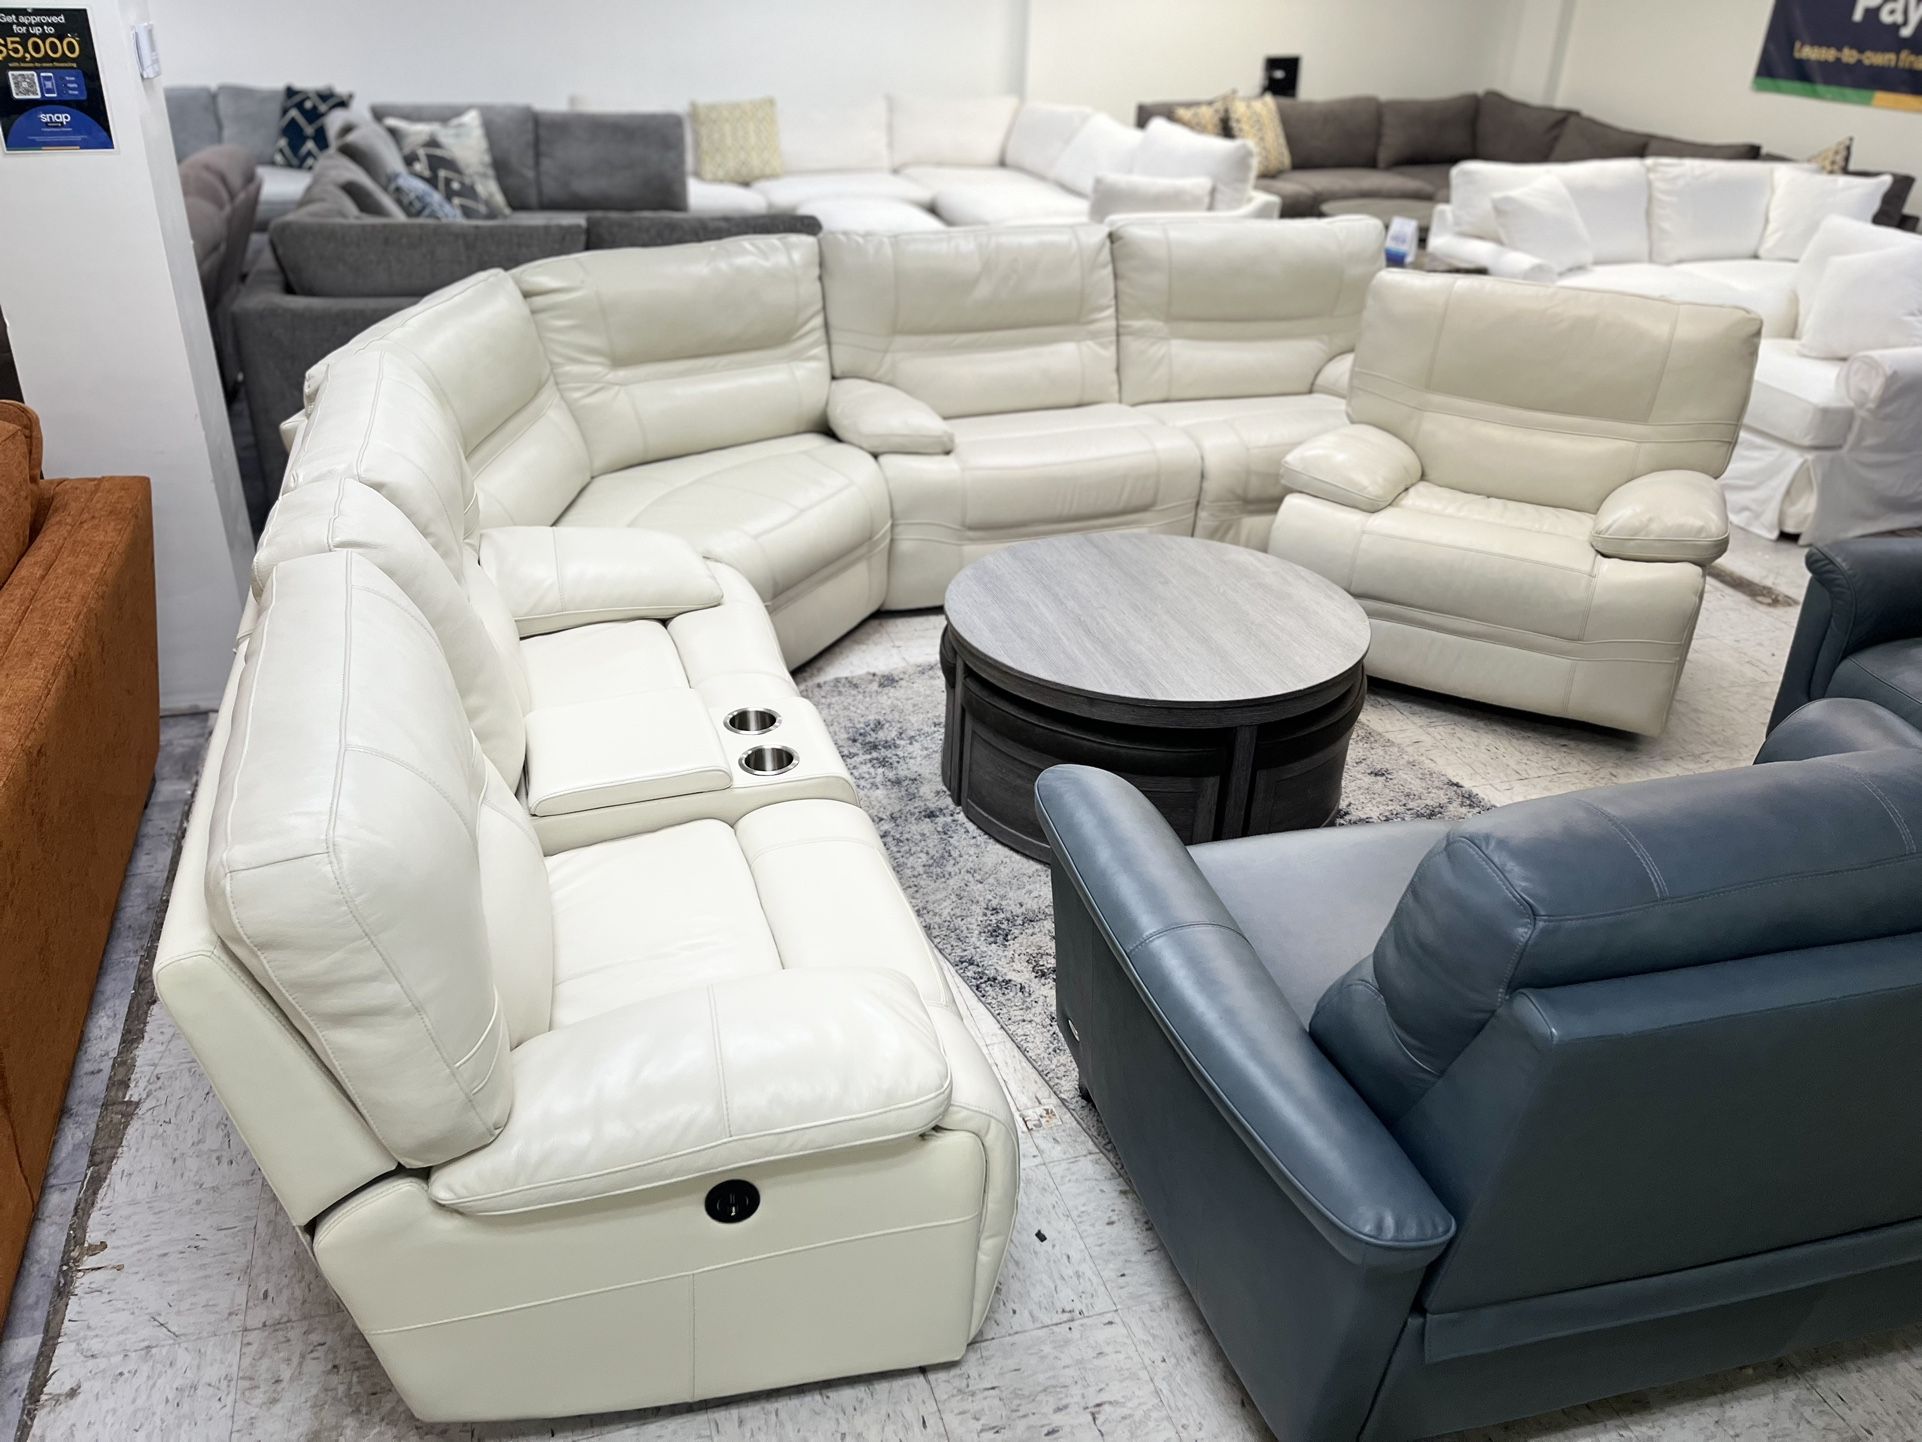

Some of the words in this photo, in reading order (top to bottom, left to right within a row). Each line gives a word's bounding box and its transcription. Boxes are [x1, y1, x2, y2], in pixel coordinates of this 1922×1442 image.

[19, 14, 65, 24] approved
[13, 25, 27, 33] for
[29, 26, 42, 35] up
[44, 26, 55, 34] to
[1793, 40, 1897, 67] Lease-to-own
[40, 113, 71, 125] snap
